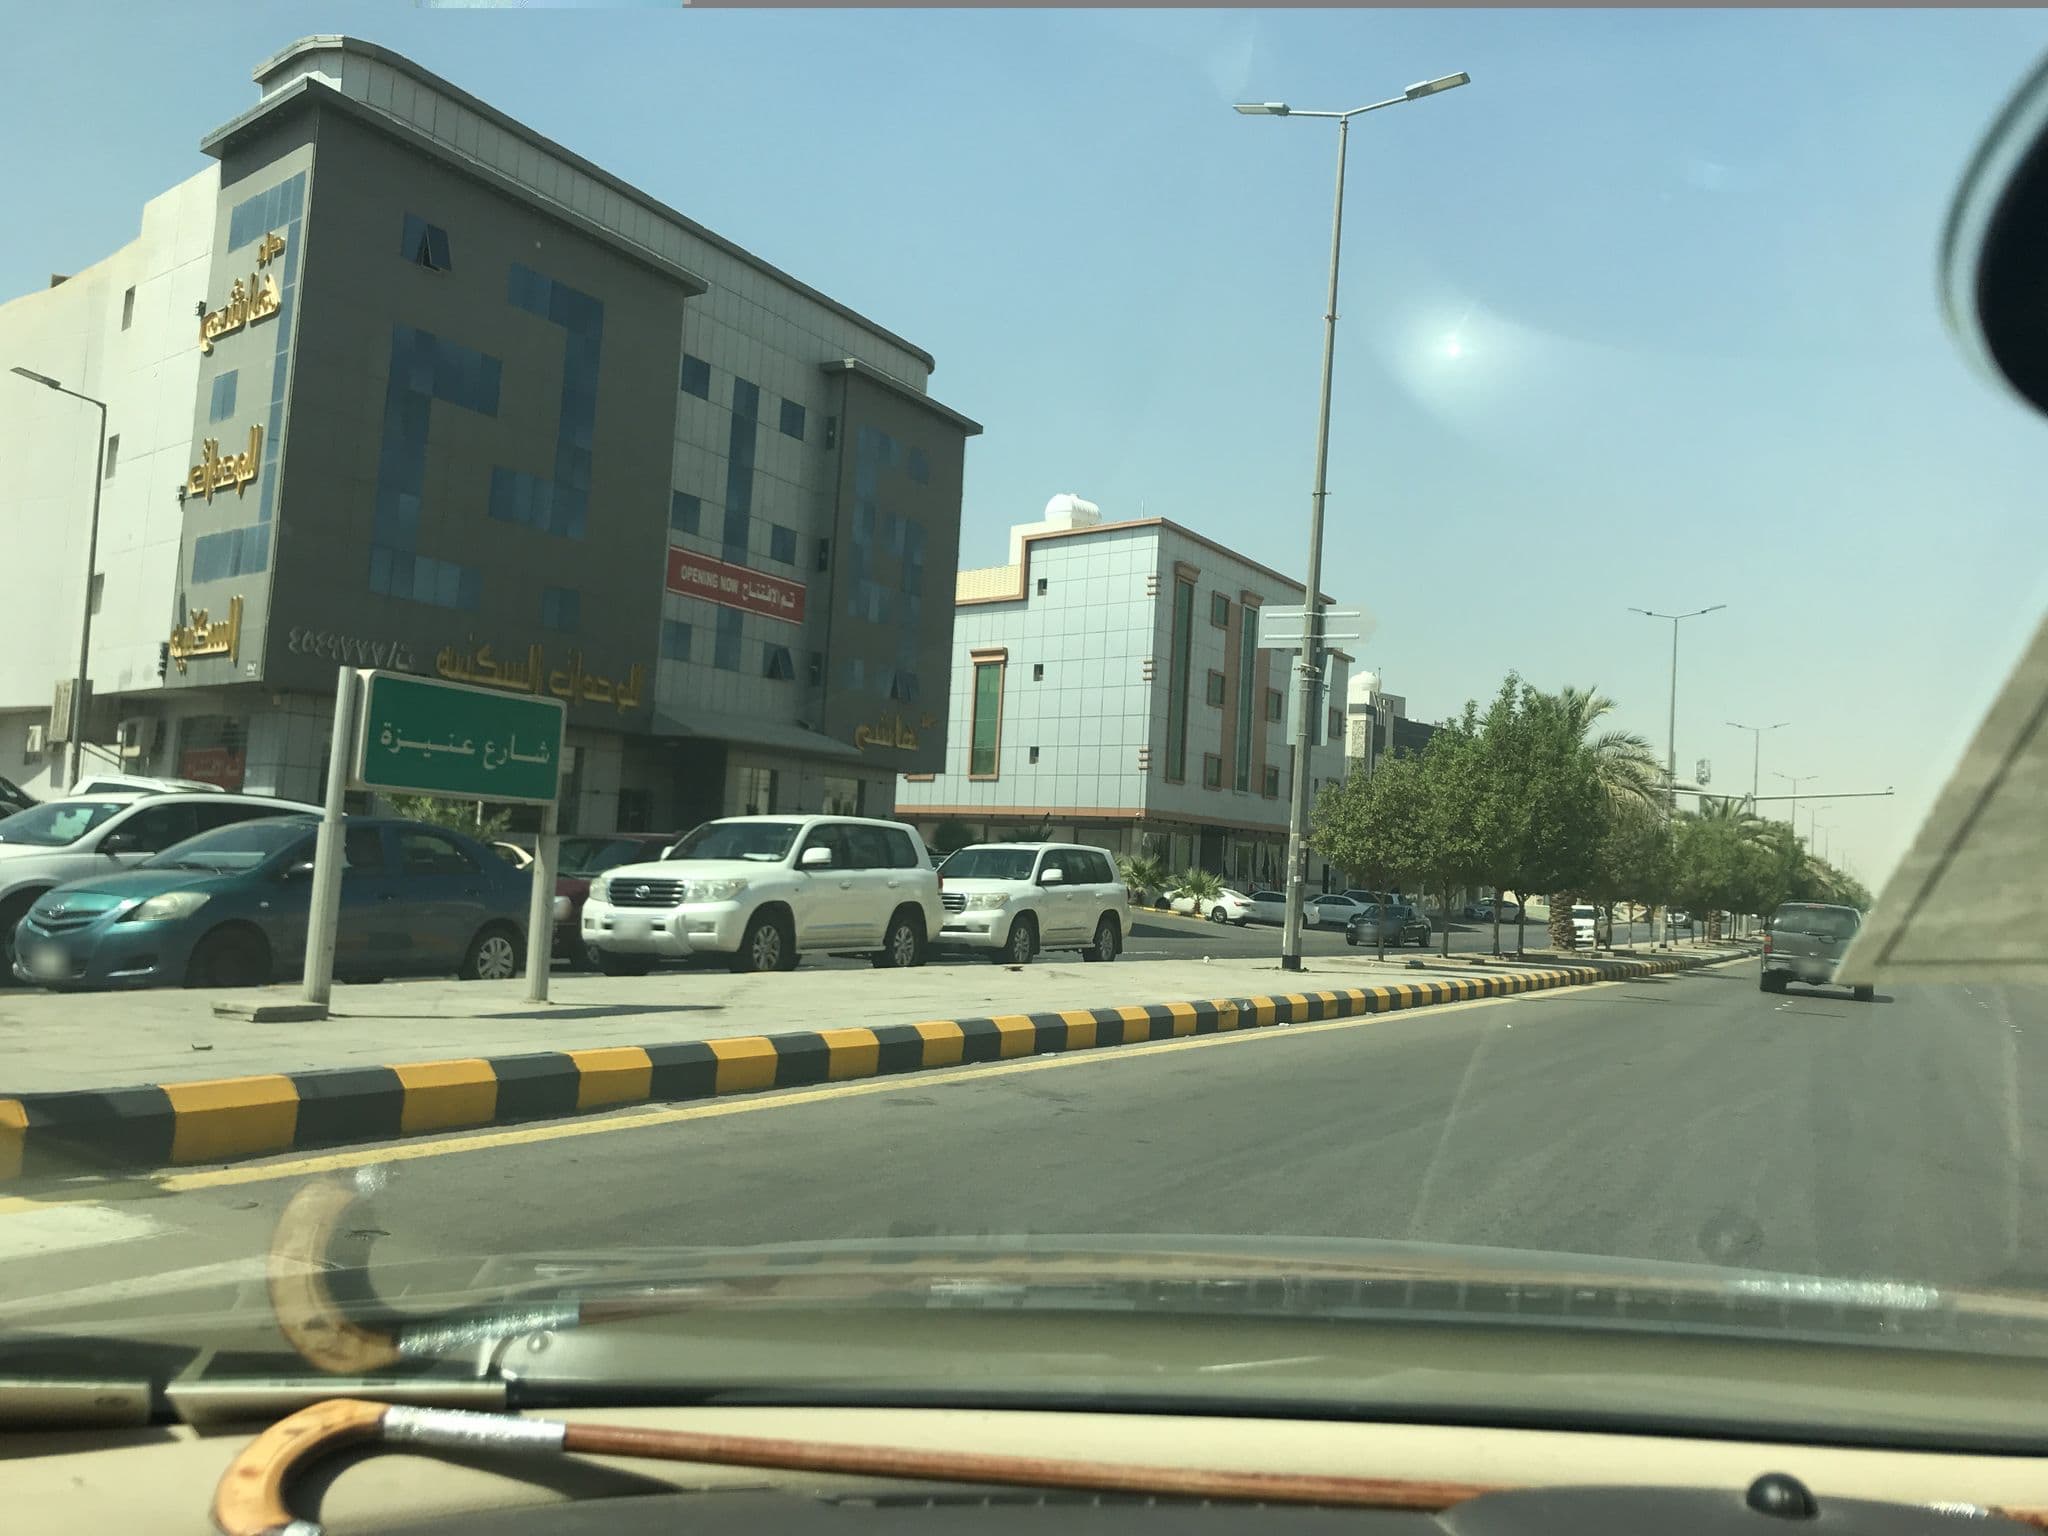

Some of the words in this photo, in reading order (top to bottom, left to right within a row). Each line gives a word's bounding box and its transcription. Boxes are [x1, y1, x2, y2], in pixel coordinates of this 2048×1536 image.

[200, 272, 282, 351] هاشم
[680, 565, 719, 589] OPENING
[719, 575, 740, 594] NOW
[170, 594, 244, 673] السكنية
[380, 721, 476, 758] عنيزة
[482, 732, 551, 770] شارع
